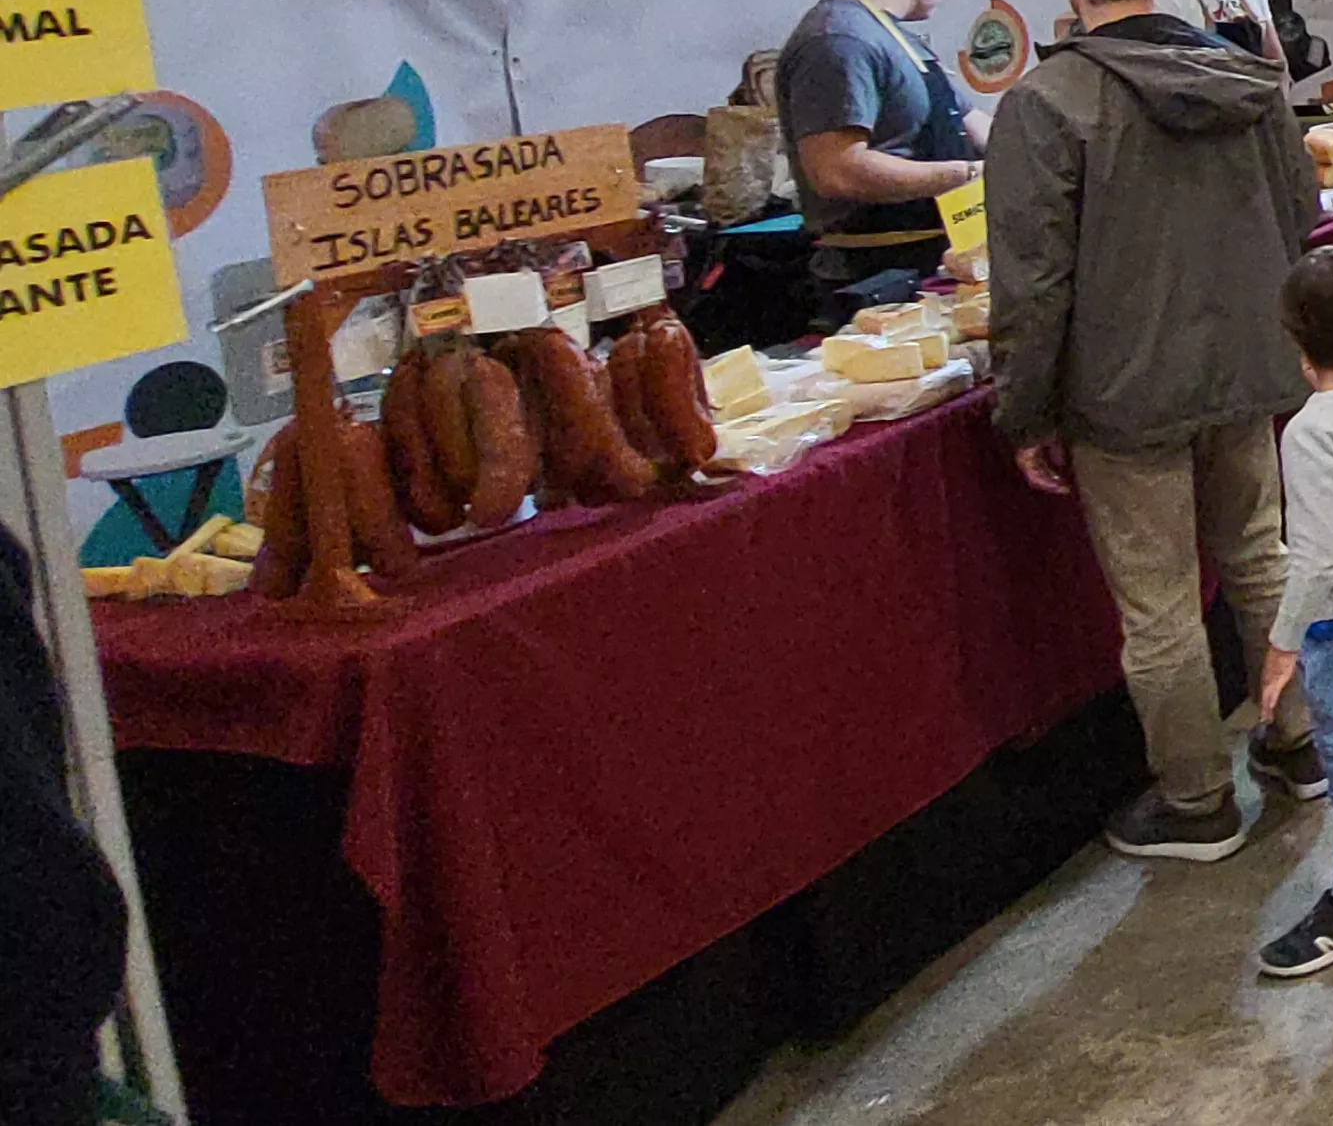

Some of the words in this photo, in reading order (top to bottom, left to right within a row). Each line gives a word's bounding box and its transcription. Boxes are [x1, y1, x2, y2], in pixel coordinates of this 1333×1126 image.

[0, 8, 93, 44] MAL
[332, 135, 566, 209] SOBRASADA
[0, 213, 155, 270] ASADA
[311, 217, 434, 272] ISLAS
[454, 187, 603, 241] BALEARES
[0, 266, 119, 323] ANTE
